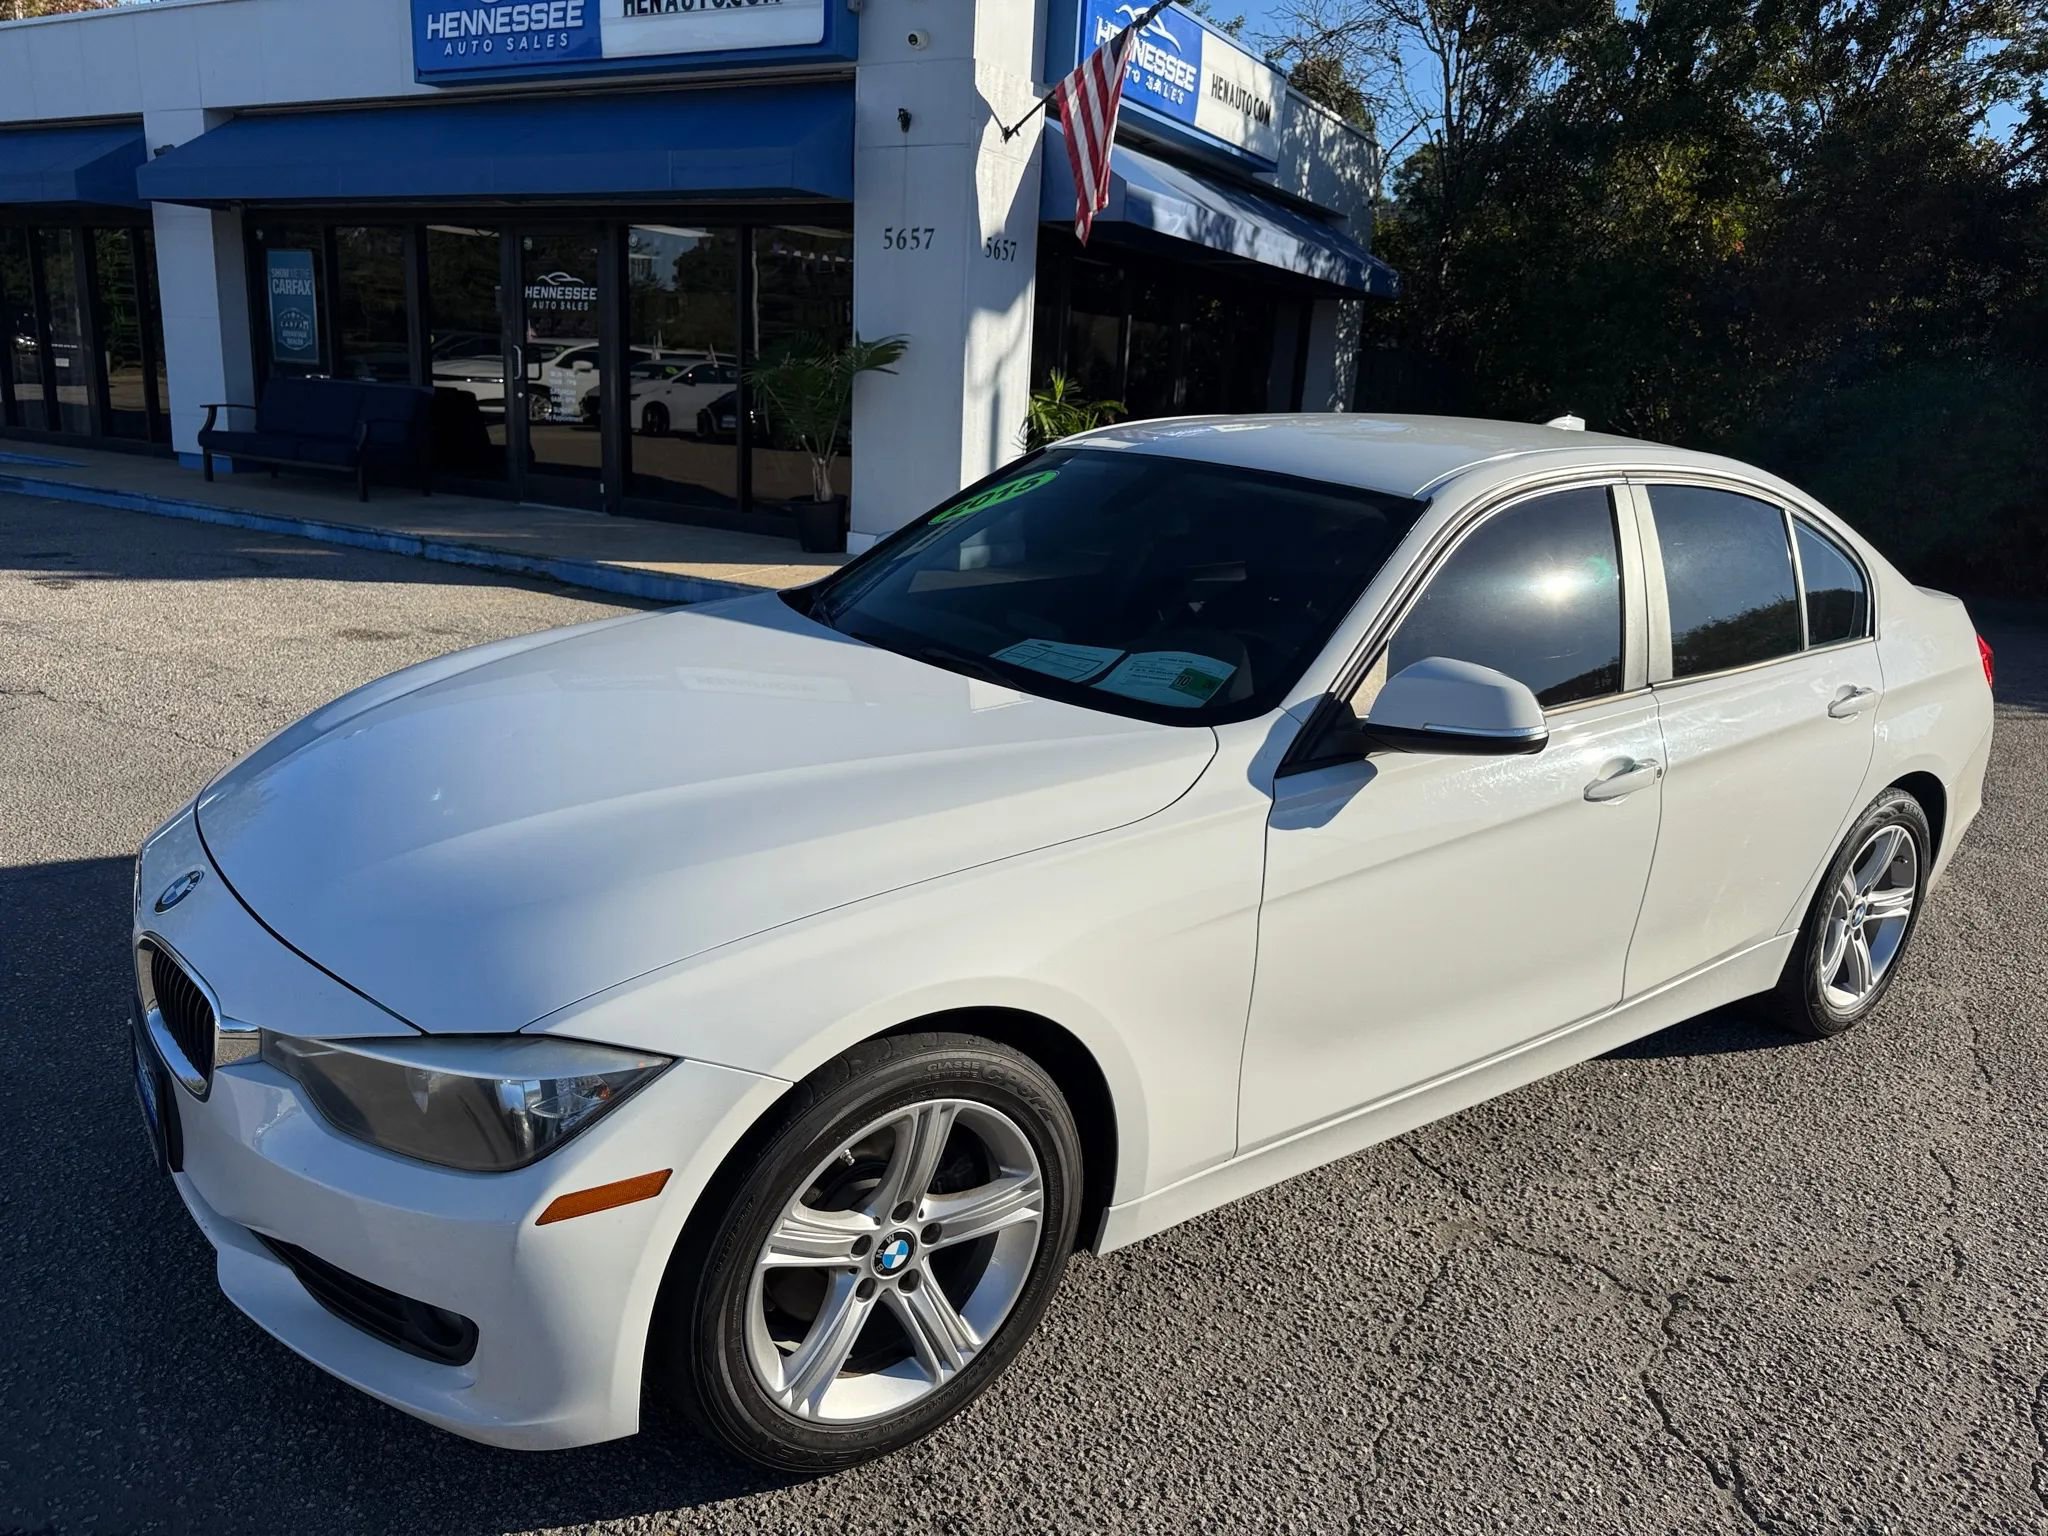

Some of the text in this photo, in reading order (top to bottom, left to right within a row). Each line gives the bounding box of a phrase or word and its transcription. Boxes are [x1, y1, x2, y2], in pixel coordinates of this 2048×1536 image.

[427, 4, 584, 40] HENNESSEE
[444, 32, 570, 56] AUTO SALES
[1095, 15, 1197, 93] HNESSEE
[1145, 74, 1185, 105] SALES
[883, 227, 936, 250] 5657
[985, 237, 1017, 262] 5657
[272, 279, 312, 296] CARFAX
[524, 285, 599, 300] HENNESSEE
[532, 300, 589, 311] AUTO SALES
[939, 473, 1048, 521] 2015
[875, 1234, 895, 1272] BMW
